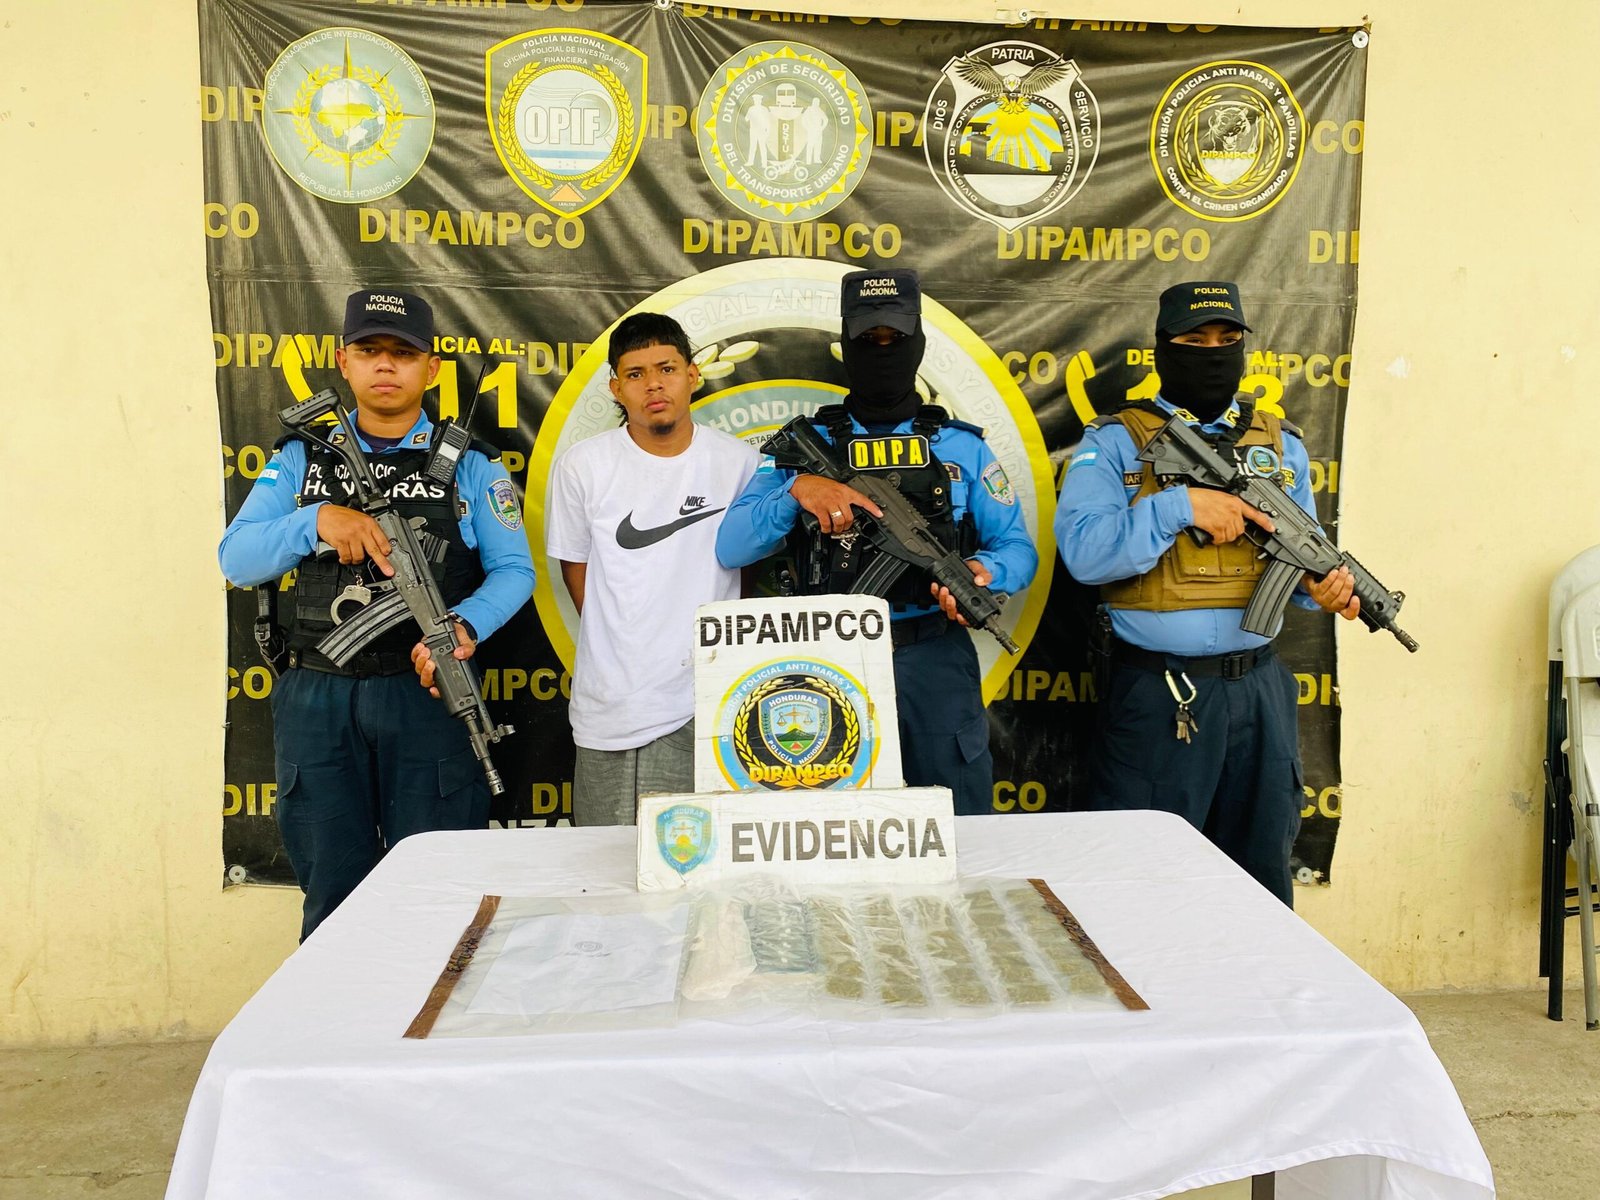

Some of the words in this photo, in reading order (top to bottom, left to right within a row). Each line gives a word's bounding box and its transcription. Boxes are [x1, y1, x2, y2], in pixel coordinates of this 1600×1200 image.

[522, 34, 558, 50] POLICÍA
[560, 35, 607, 52] NACIONAL
[991, 47, 1036, 61] PATRIA
[285, 36, 321, 61] NACIONAL
[321, 31, 333, 40] DE
[333, 30, 396, 53] INVESTIGACIÓN
[394, 49, 401, 58] E
[400, 55, 431, 108] INTELIGENCIA
[503, 50, 531, 69] OFICINA
[530, 45, 565, 57] POLICIAL
[576, 46, 631, 73] INVESTIGACIÓN
[543, 56, 589, 66] FINANCIERA
[1212, 67, 1238, 79] ANTI
[1172, 73, 1212, 108] POLICIAL
[1239, 68, 1276, 90] MARAS
[1273, 87, 1282, 97] Y
[722, 68, 767, 124] DIVISIÓN
[770, 63, 789, 74] DE
[792, 64, 851, 126] SEGURIDAD
[523, 105, 601, 146] OPIF
[932, 98, 949, 131] DIOS
[1074, 90, 1094, 149] SERVICIO
[1277, 97, 1298, 160] PANDILLAS
[1160, 107, 1175, 158] DIVISIÓN
[949, 141, 957, 156] DE
[954, 95, 990, 137] CONTROL
[1044, 115, 1075, 204] PENITENCIARIOS
[723, 142, 738, 168] DEL
[736, 166, 814, 200] TRANSPORTE
[815, 143, 850, 189] URBANO
[342, 190, 356, 199] DE
[356, 174, 404, 198] HONDURAS
[1166, 166, 1192, 201] CONTRA
[1191, 195, 1203, 207] EL
[1202, 201, 1239, 212] CRIMEN
[1238, 169, 1289, 211] ORGANIZADO
[359, 207, 586, 250] DIPAMPCO
[682, 218, 902, 259] DIPAMPCO
[996, 225, 1211, 262] DIPAMPCO
[859, 287, 899, 297] NACIONAL
[864, 278, 896, 288] POLICIA
[1194, 287, 1229, 295] POLICIA
[365, 303, 408, 316] NACIONAL
[369, 294, 404, 306] POLICIA
[1190, 300, 1234, 311] NACIONAL
[854, 438, 924, 468] DNPA
[684, 495, 706, 507] NIKE
[699, 608, 885, 648] DIPAMPCO
[741, 665, 784, 692] POLICIAL
[785, 663, 810, 672] ANTI
[811, 664, 845, 686] MARAS
[843, 680, 852, 690] Y
[768, 694, 819, 708] HONDURAS
[798, 736, 825, 765] NACIONAL
[748, 763, 854, 783] DIPAMPCO
[730, 817, 948, 863] EVIDENCIA
